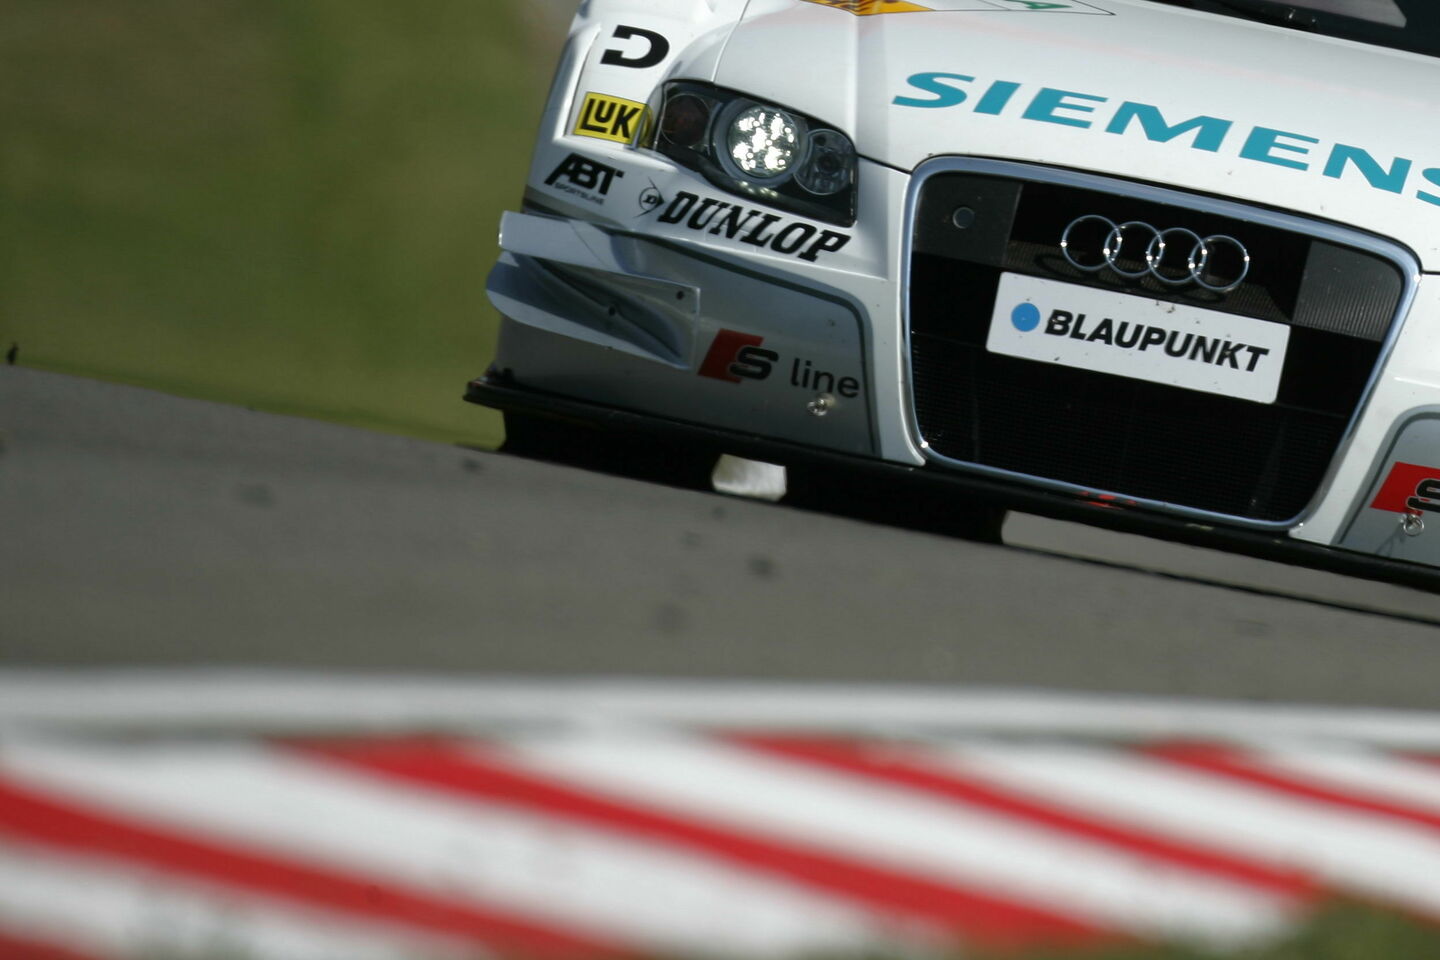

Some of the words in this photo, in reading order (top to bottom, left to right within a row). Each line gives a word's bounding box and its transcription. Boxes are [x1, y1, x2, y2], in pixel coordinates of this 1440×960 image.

[544, 152, 625, 195] ABT
[657, 190, 852, 263] DUNLOP
[1044, 309, 1270, 373] BLAUPUNKT
[729, 346, 780, 380] S
[790, 357, 860, 399] line
